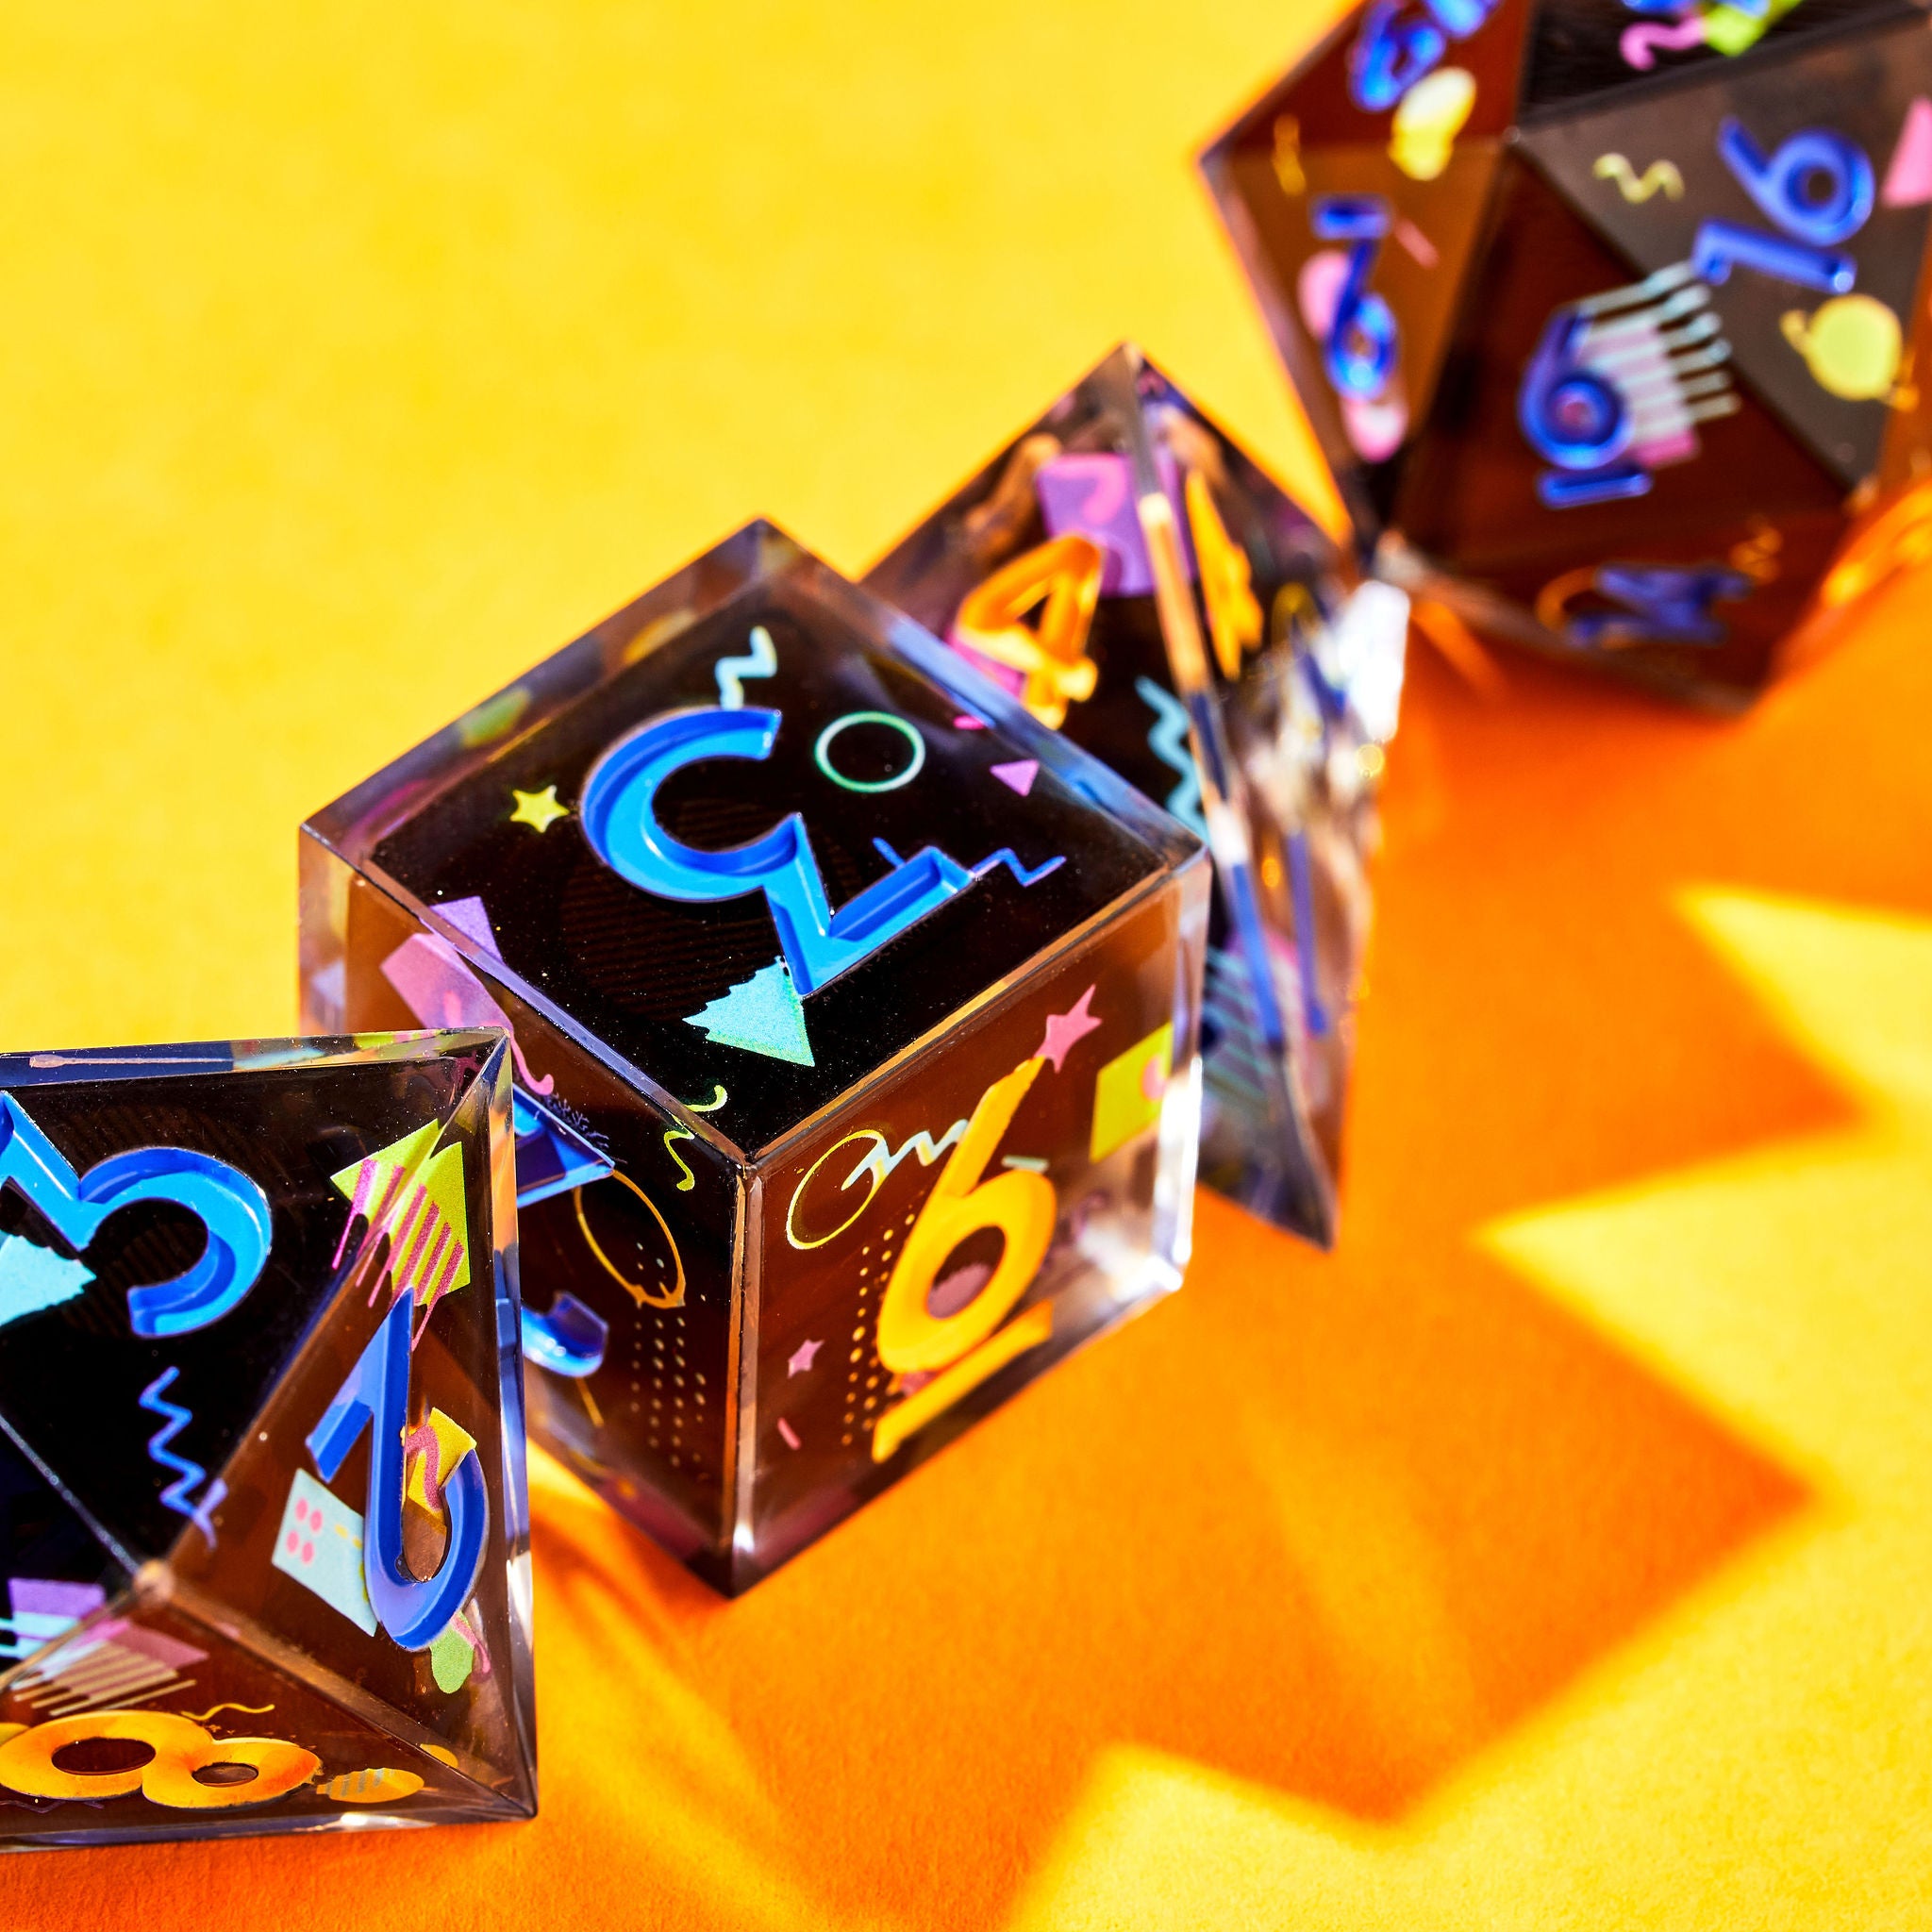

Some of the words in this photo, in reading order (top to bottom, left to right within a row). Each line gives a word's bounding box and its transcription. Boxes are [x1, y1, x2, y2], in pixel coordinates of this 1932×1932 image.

[954, 530, 1103, 730] 4
[579, 707, 977, 998] 3
[873, 1054, 1058, 1463] 6
[0, 1708, 323, 1810] 8
